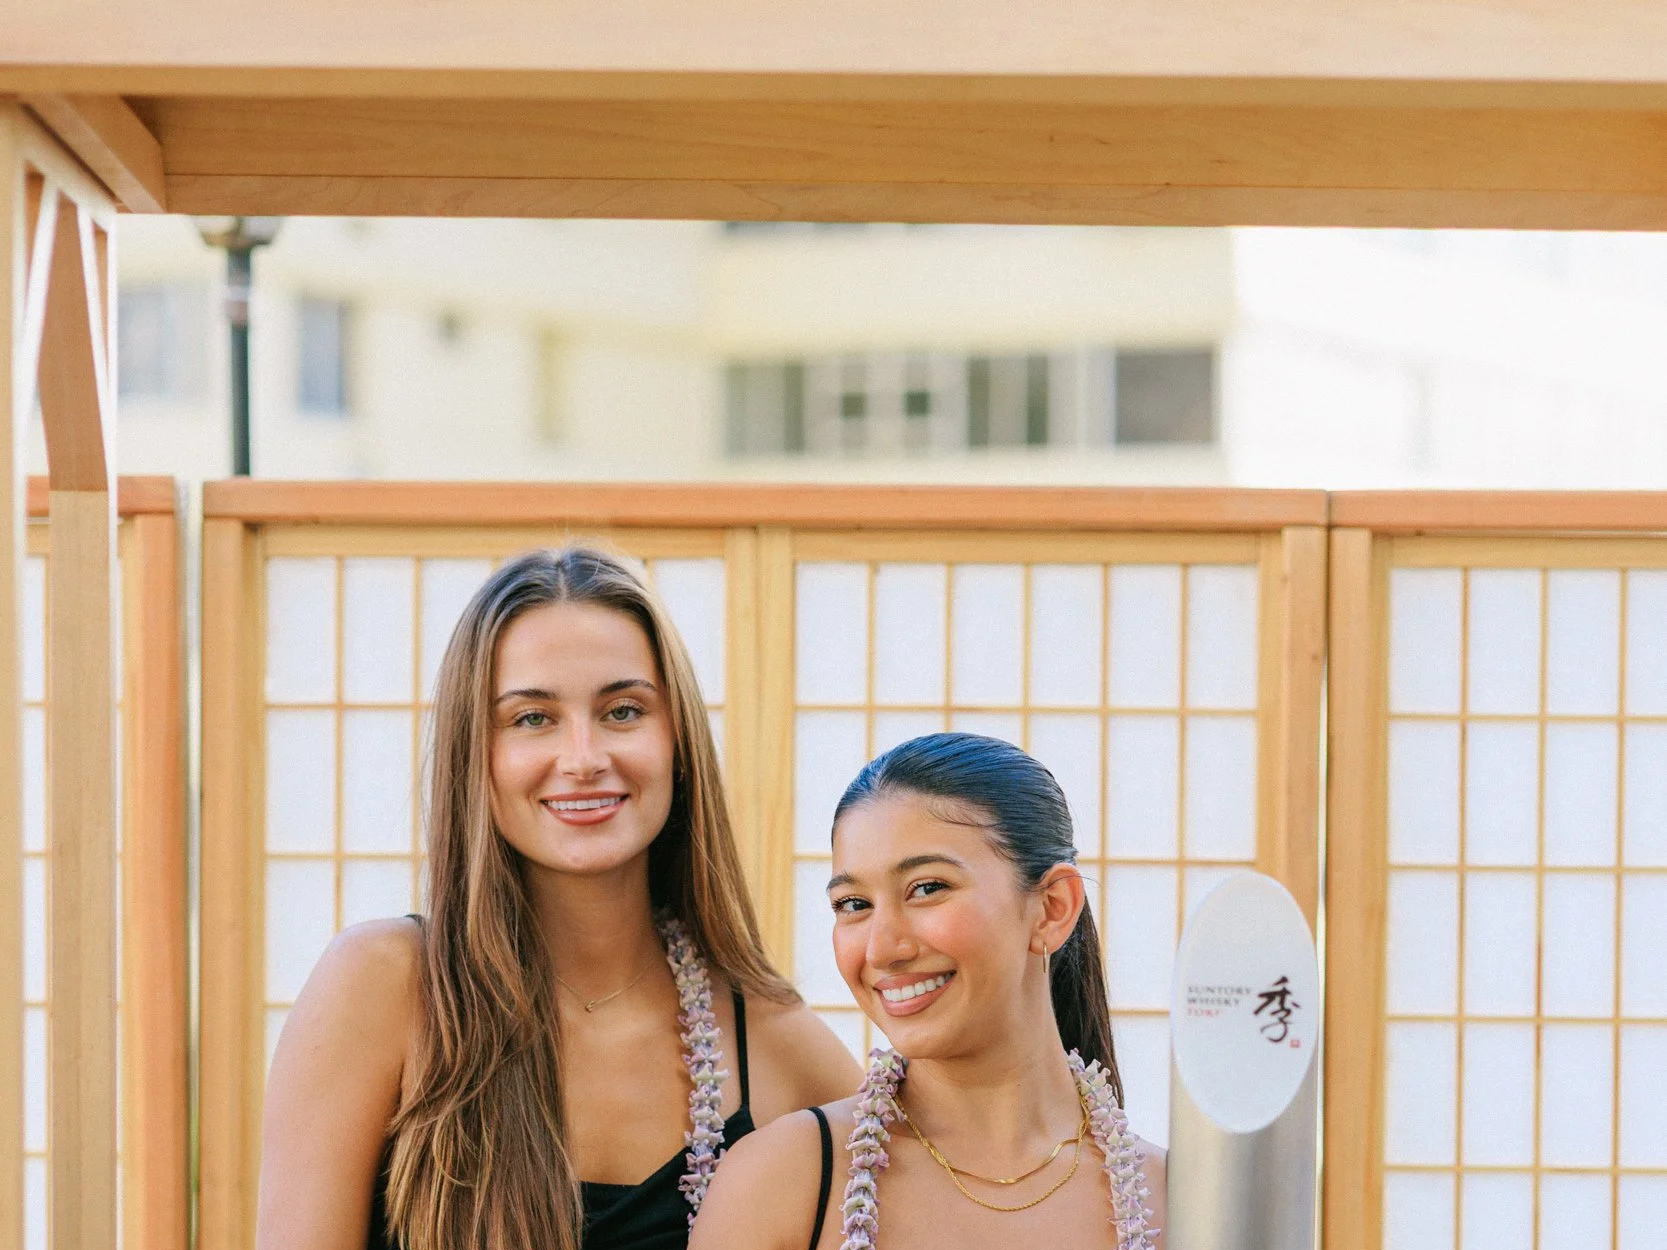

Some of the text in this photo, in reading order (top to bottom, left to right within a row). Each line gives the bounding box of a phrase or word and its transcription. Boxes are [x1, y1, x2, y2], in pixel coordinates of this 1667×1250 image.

[1188, 985, 1252, 996] SUNTORY
[1187, 997, 1240, 1006] WHISKY
[1188, 1008, 1222, 1017] TOKI
